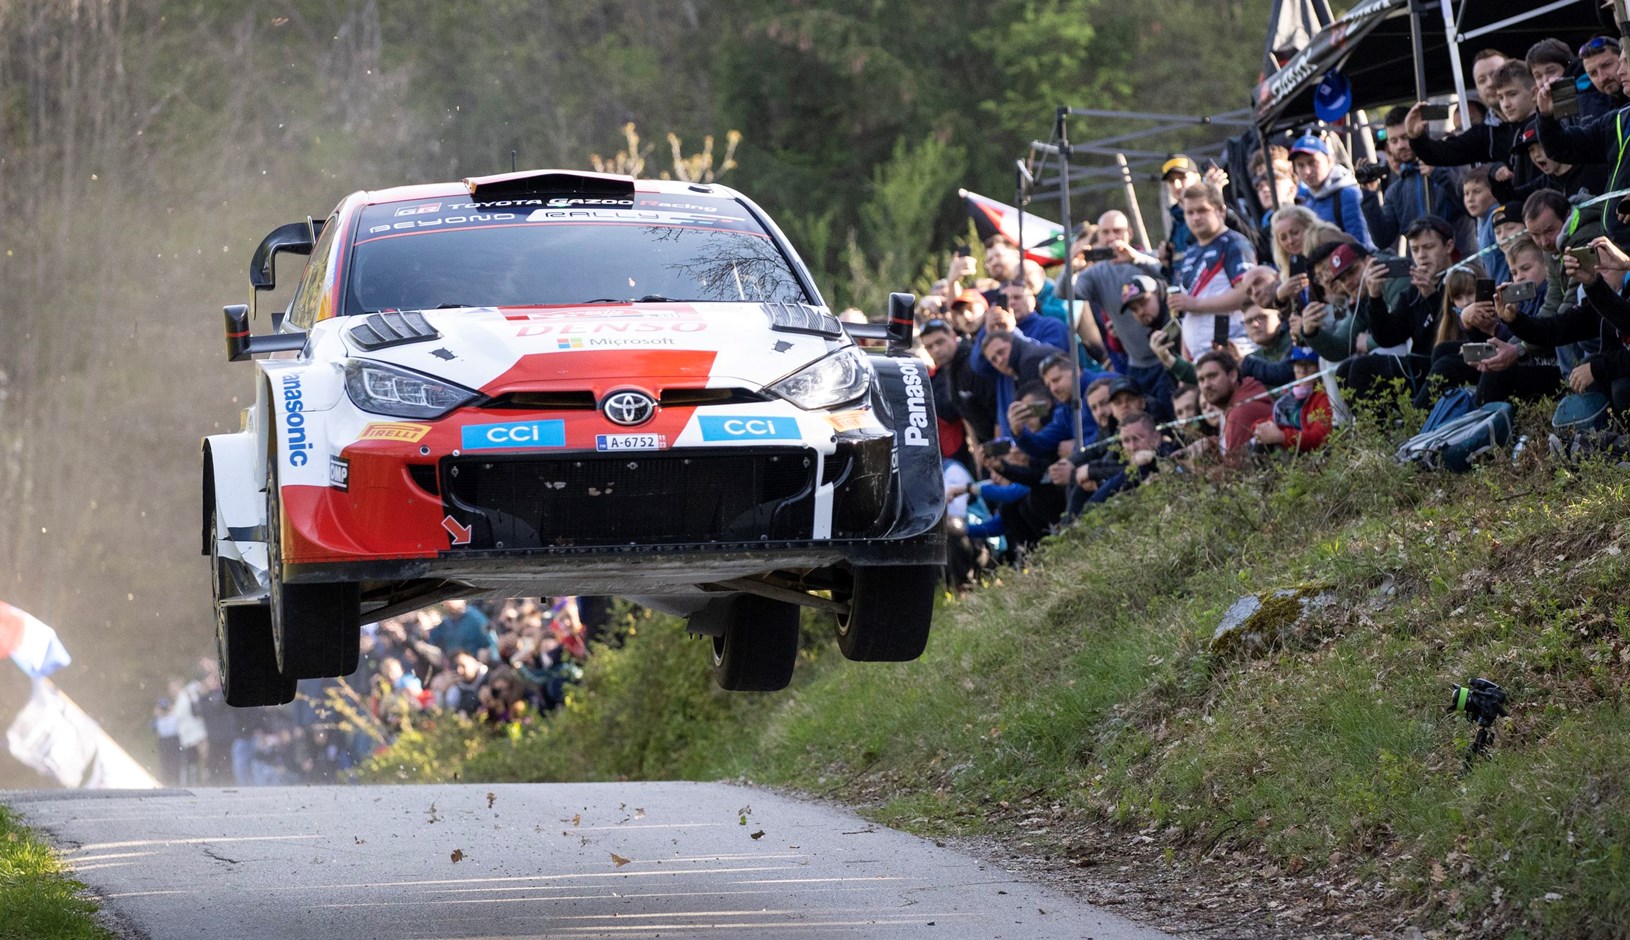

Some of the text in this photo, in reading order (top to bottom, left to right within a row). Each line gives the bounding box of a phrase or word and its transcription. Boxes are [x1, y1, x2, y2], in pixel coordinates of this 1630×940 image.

[448, 199, 543, 210] TOYOTA
[547, 197, 634, 208] GAZOO
[639, 200, 718, 213] Racing
[369, 211, 659, 233] BEYOND RALLY
[516, 322, 709, 337] DENSO
[589, 337, 675, 346] Microsoft
[899, 357, 930, 447] Panason
[282, 371, 313, 467] anasonic
[362, 424, 424, 439] PIRELLI
[611, 436, 655, 448] A-6752
